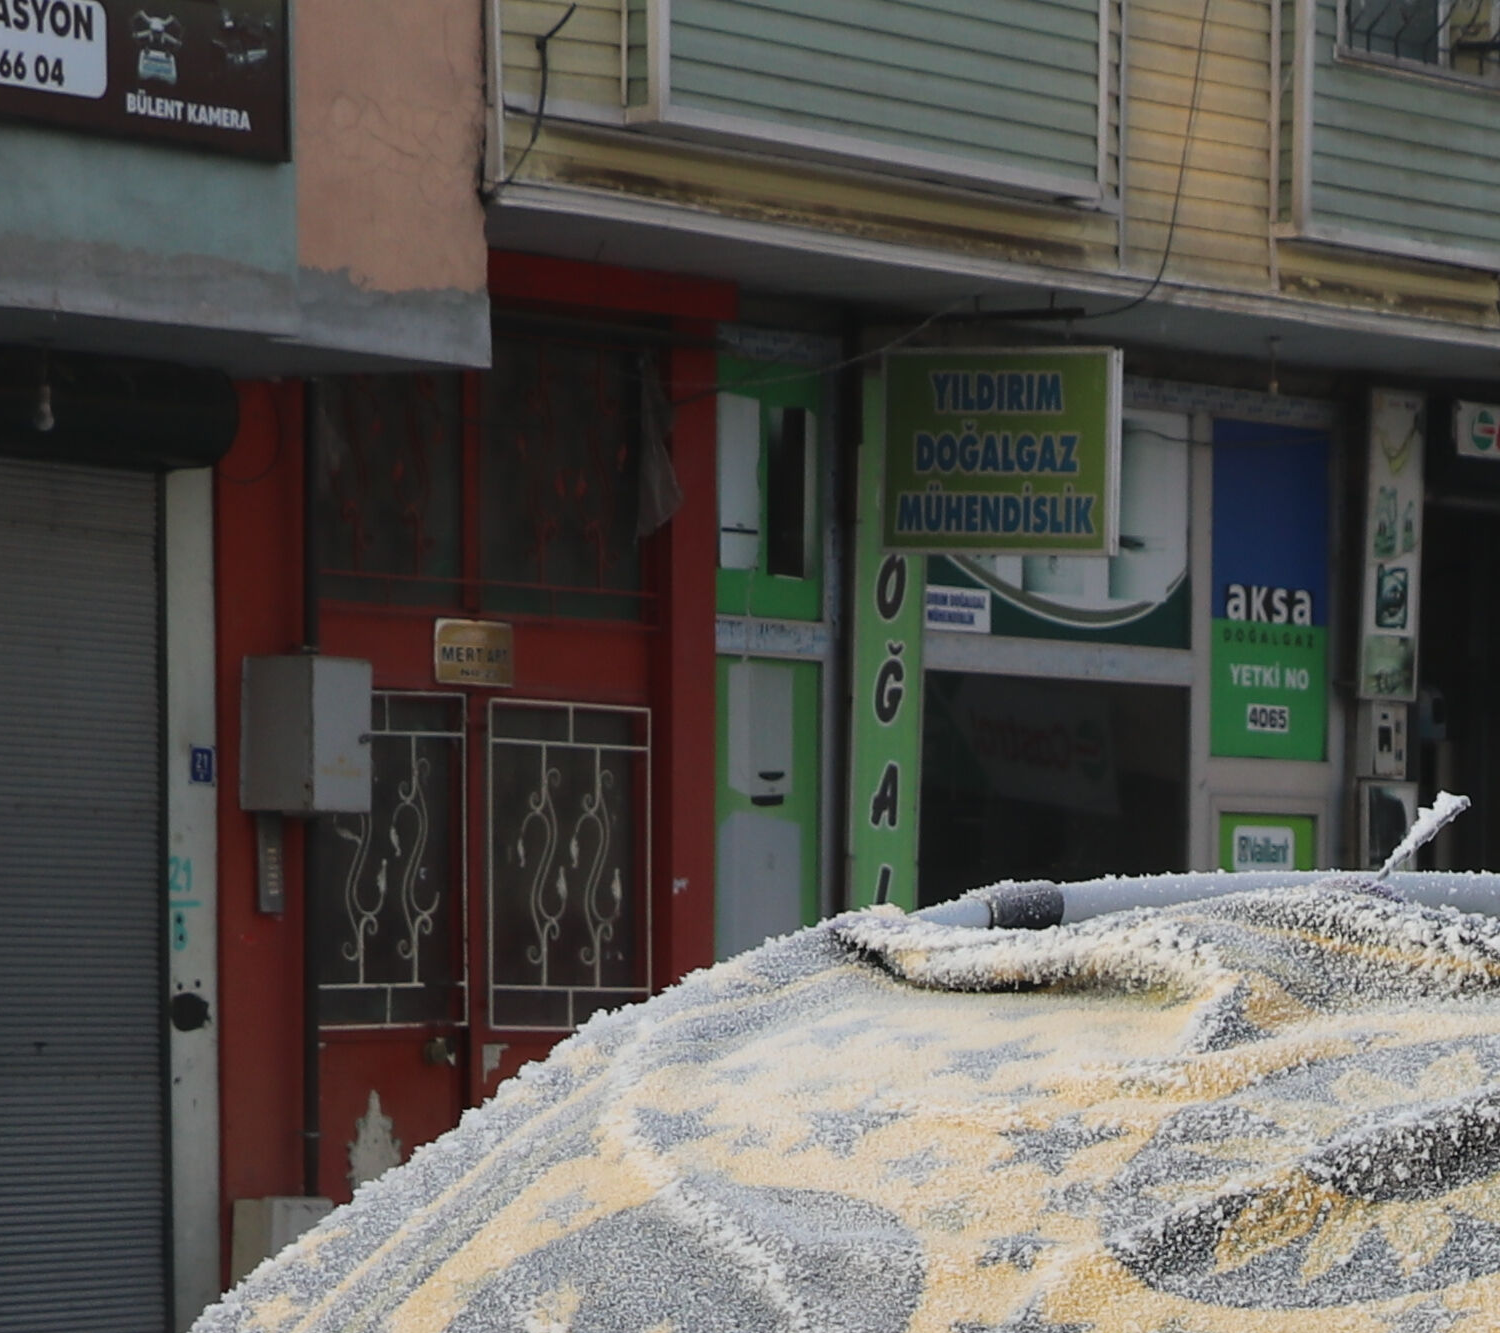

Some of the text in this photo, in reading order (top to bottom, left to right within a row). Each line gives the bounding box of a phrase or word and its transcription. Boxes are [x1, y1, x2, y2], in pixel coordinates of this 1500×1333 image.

[0, 50, 26, 80] 66
[35, 55, 65, 86] 04
[126, 88, 252, 131] BÜLENT KAMERA
[929, 370, 1064, 413] YILDIRIM
[914, 421, 1079, 473] DOĞALGAZ
[895, 482, 1096, 535] MÜHENDİSLİK
[1226, 583, 1312, 626] aksa
[1223, 627, 1314, 649] DOĞALGAZ
[1230, 661, 1310, 691] YETKİ NO
[1248, 706, 1287, 730] 4065
